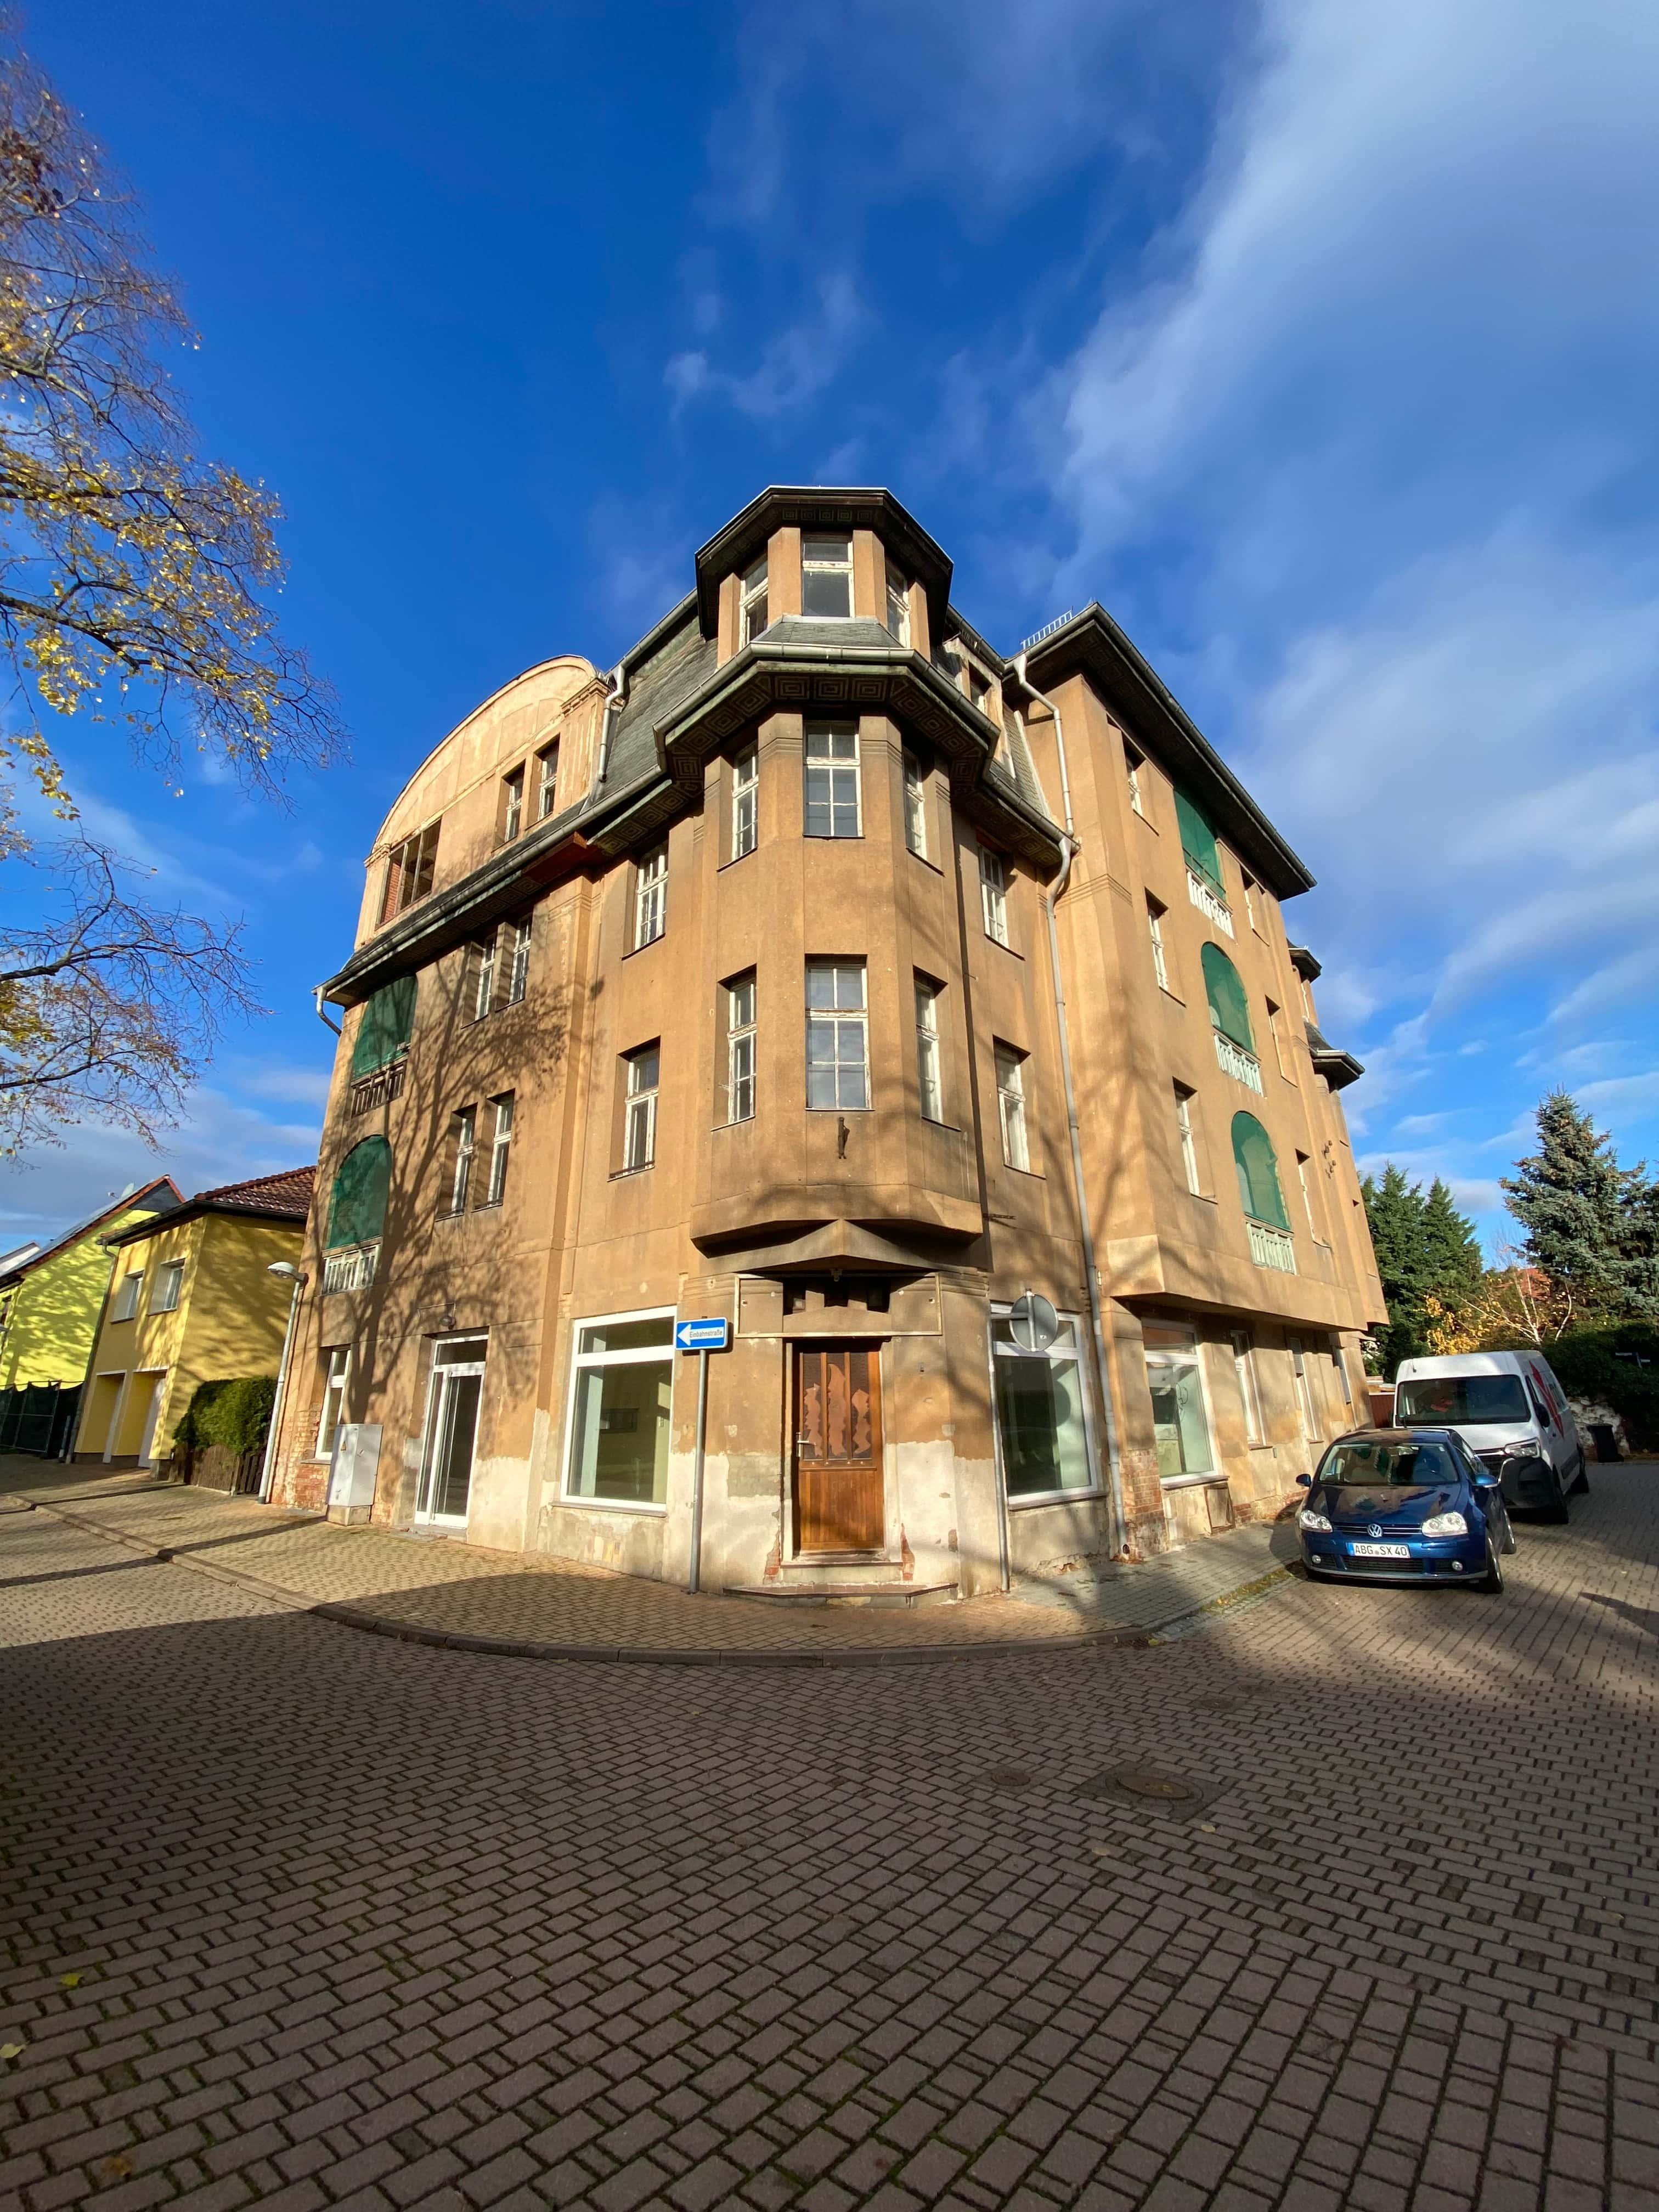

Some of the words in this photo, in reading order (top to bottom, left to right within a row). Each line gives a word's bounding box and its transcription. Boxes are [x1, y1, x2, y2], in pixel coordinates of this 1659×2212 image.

[690, 1329, 723, 1338] Einbahnstraße
[1356, 1545, 1373, 1554] ABG
[1380, 1547, 1392, 1555] SX
[1395, 1547, 1407, 1556] 40
